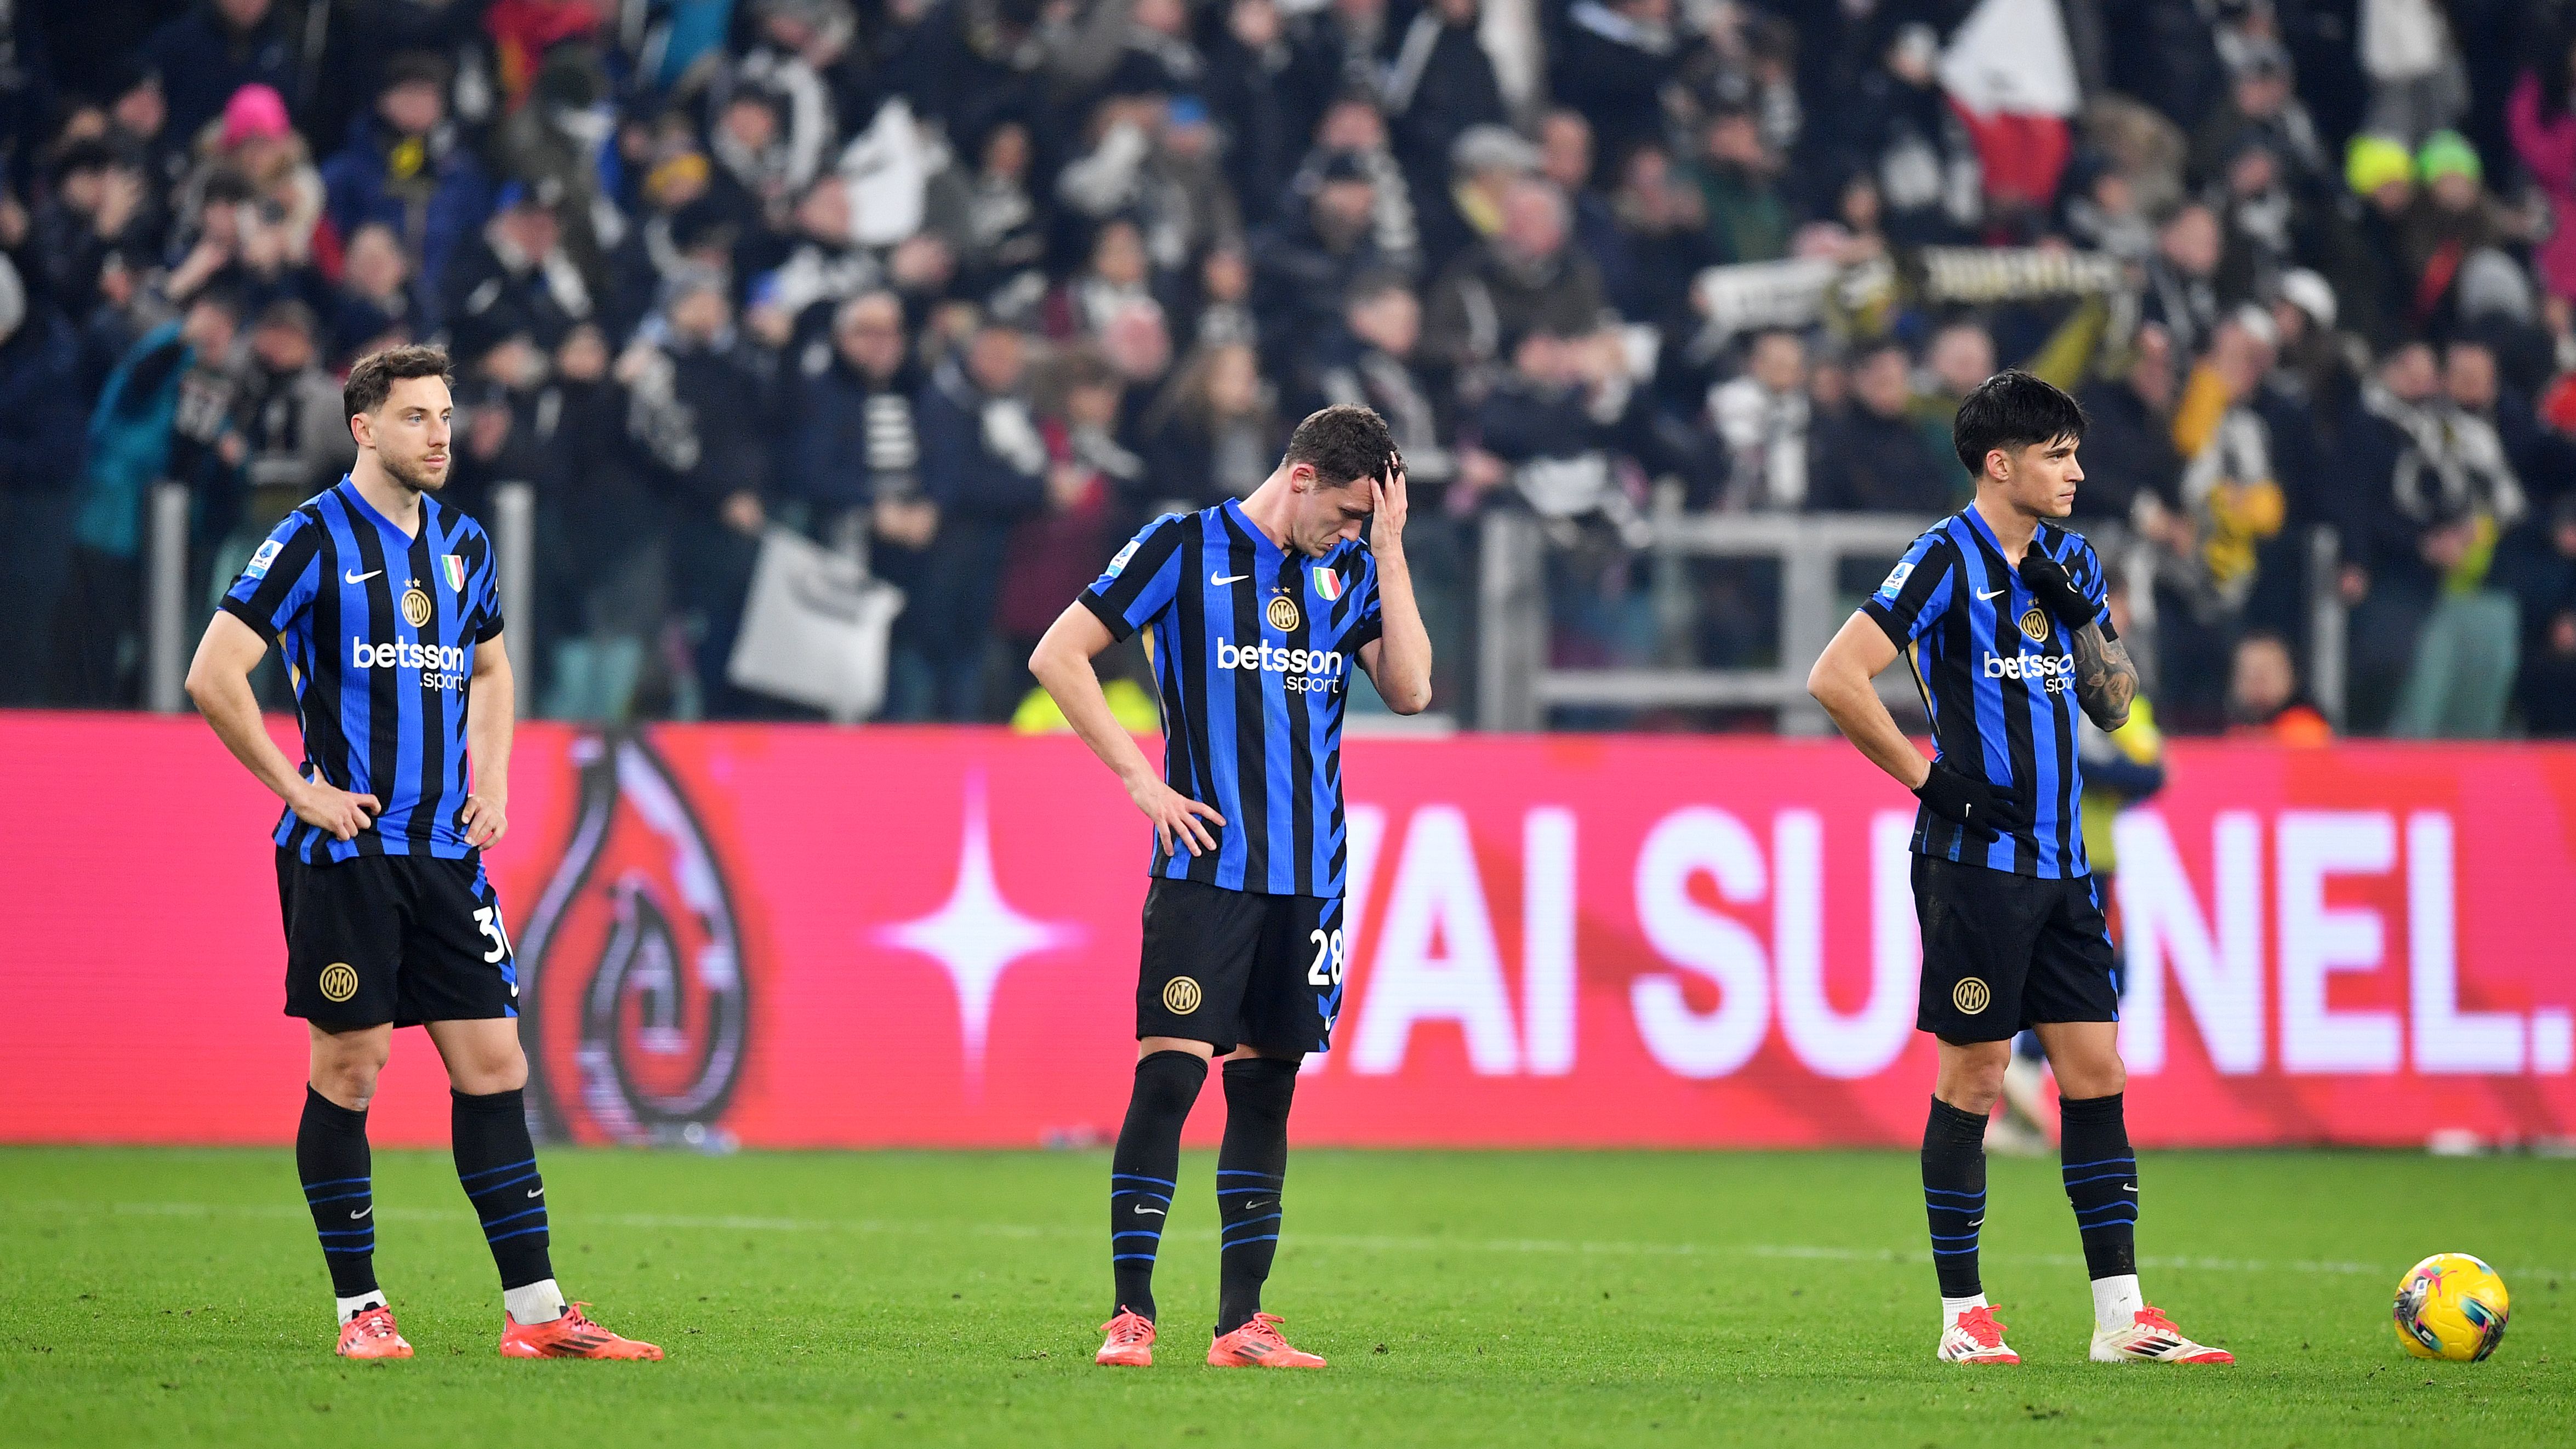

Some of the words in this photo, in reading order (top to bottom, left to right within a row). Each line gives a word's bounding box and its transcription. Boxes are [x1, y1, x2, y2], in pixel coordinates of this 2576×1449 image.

[353, 635, 464, 672] betsson
[1217, 637, 1342, 675] betsson
[1984, 649, 2076, 680] betsso
[419, 672, 464, 692] .sport
[1283, 676, 1339, 694] .sport
[2043, 677, 2077, 695] .spor
[472, 904, 514, 963] 3
[1308, 928, 1343, 985] 28
